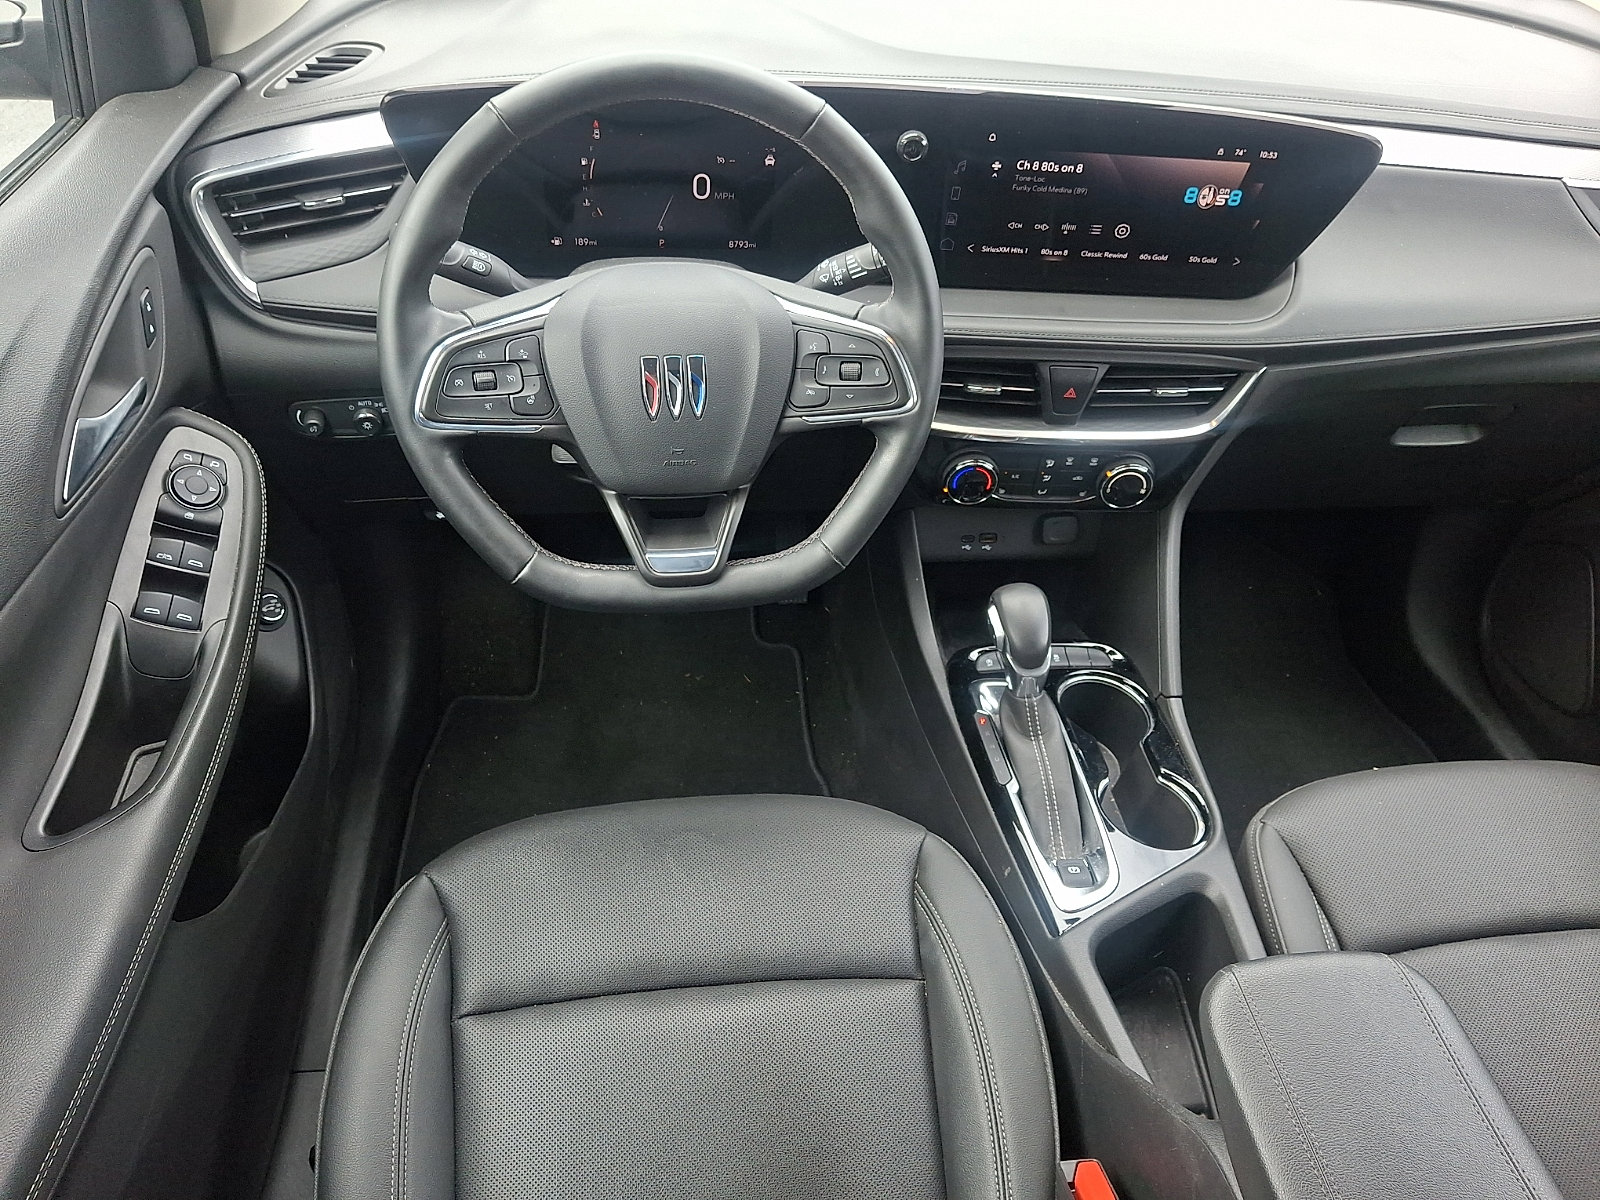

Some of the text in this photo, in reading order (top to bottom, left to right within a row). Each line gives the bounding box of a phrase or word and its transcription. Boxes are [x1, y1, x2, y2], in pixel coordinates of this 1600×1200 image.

[1259, 150, 1278, 160] 10:53
[1016, 160, 1084, 174] Ch 8 80s on 8
[1015, 174, 1046, 182] Tone-Loc
[692, 173, 735, 200] 0 MPH
[1012, 184, 1088, 196] Funky Cold Medina (89)
[658, 239, 665, 247] P
[981, 245, 1010, 254] SiriusXM
[1040, 248, 1053, 256] 80s
[1080, 250, 1128, 259] Classic Rewind
[1139, 252, 1168, 262] 60s Gold
[1202, 256, 1218, 264] Gold
